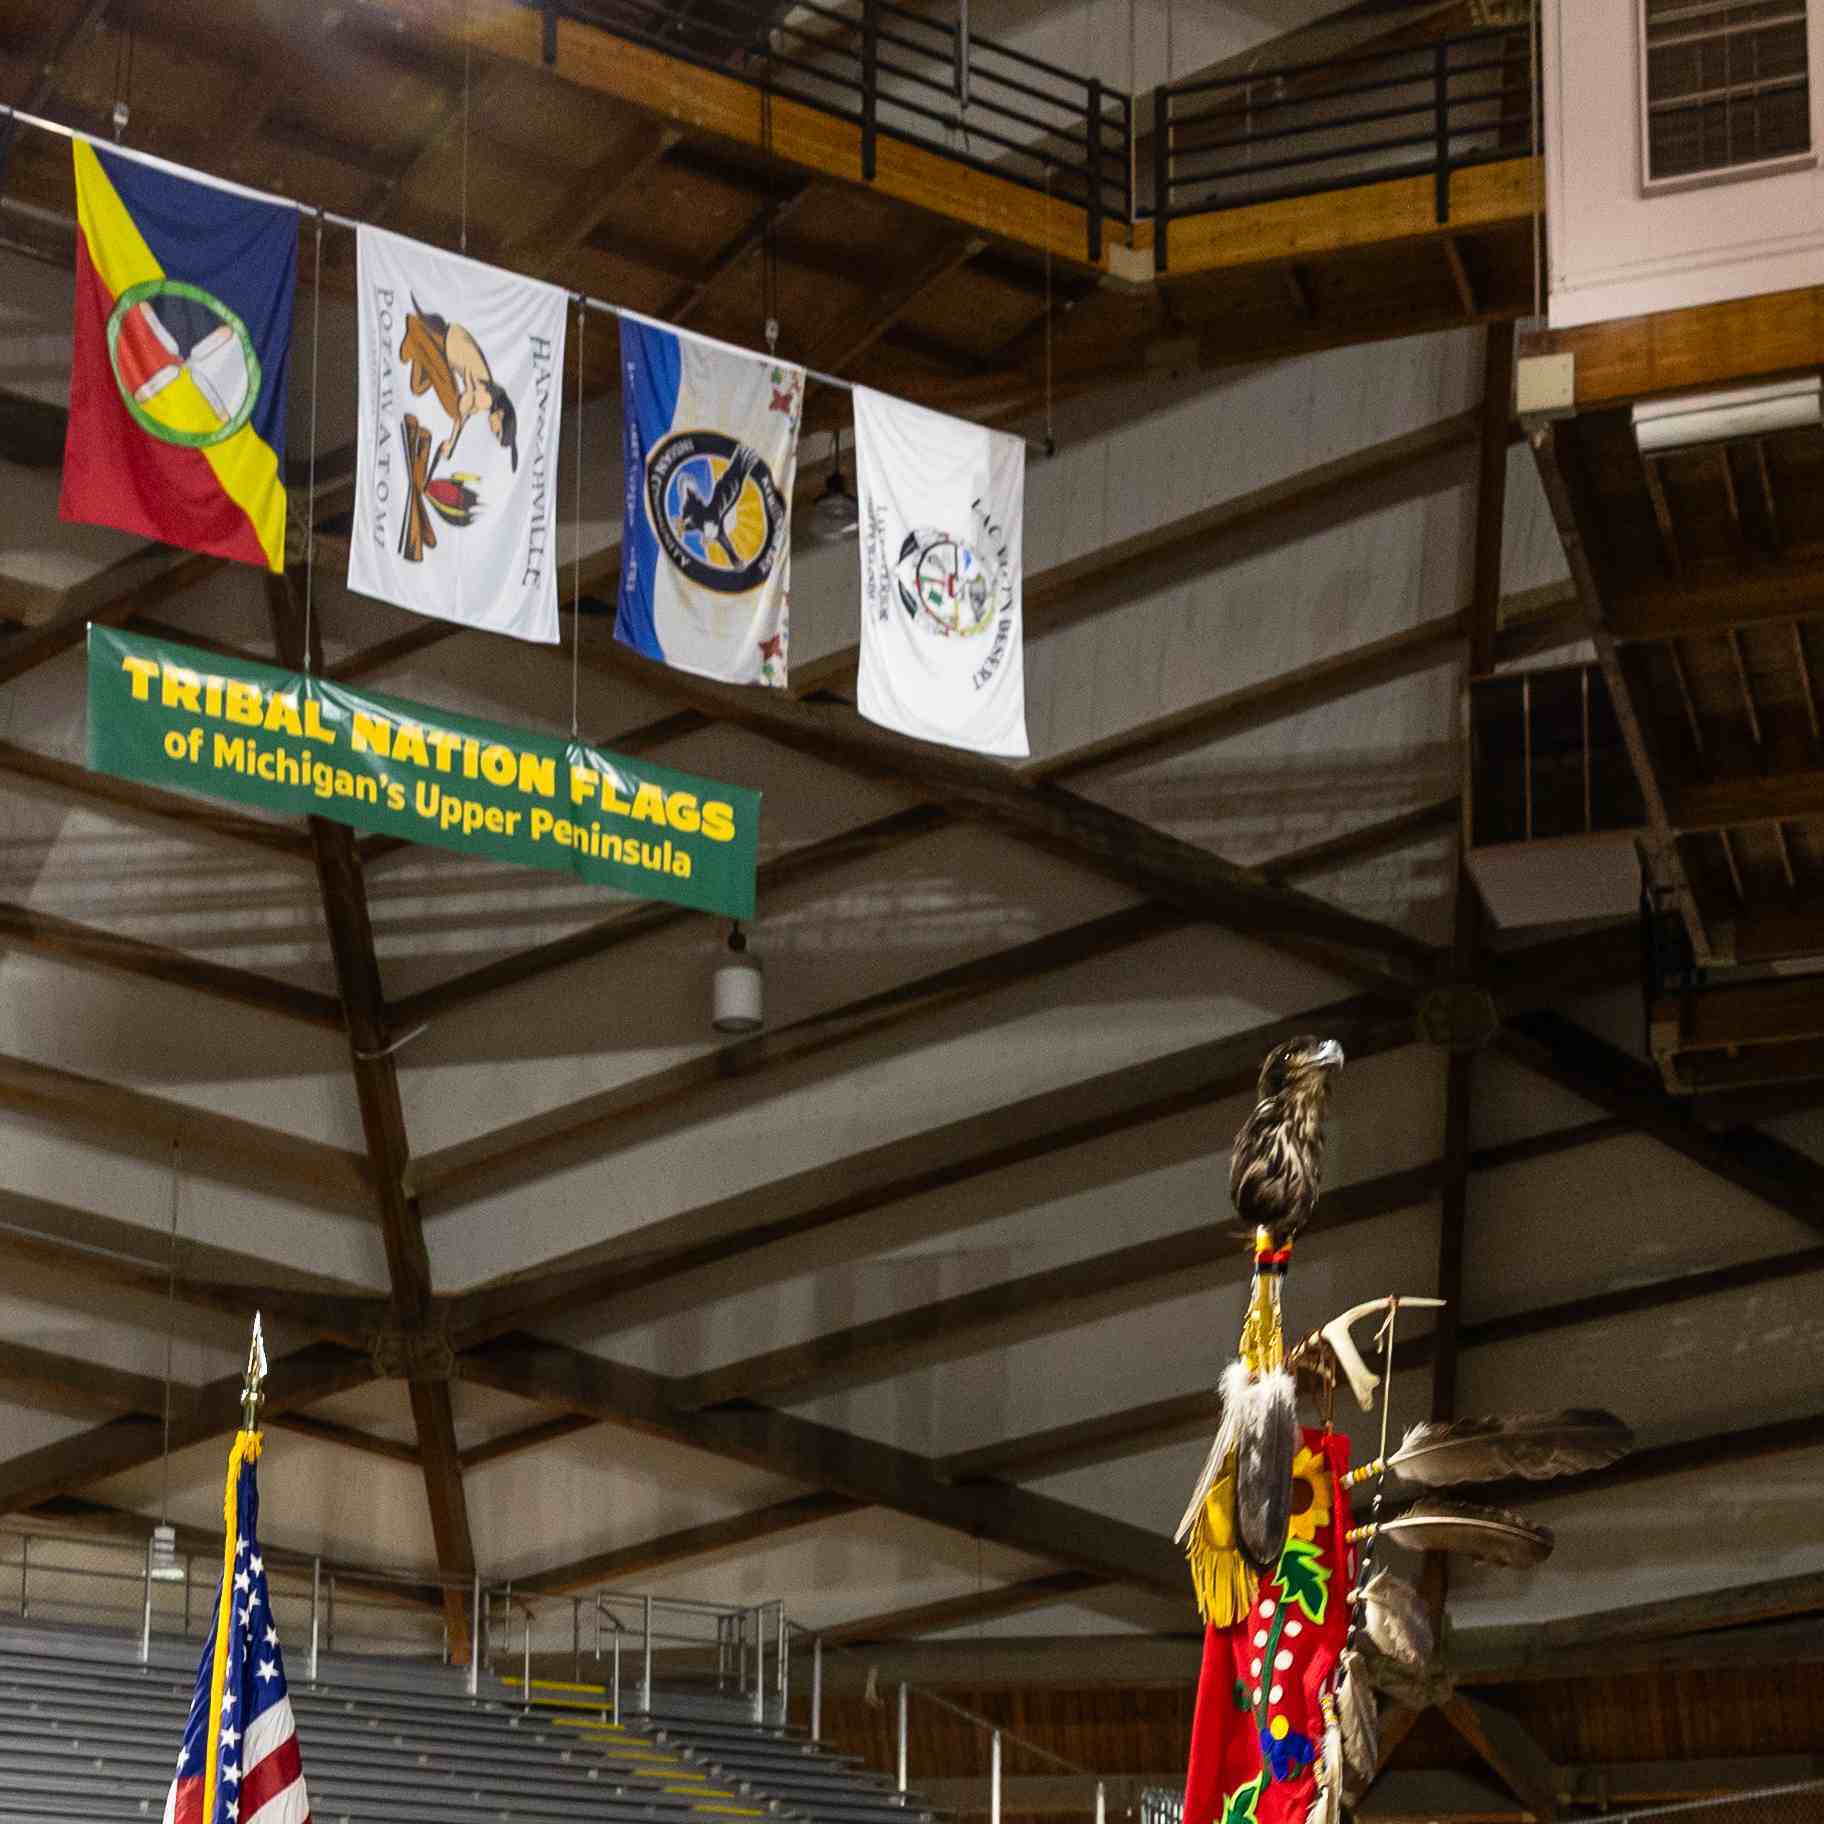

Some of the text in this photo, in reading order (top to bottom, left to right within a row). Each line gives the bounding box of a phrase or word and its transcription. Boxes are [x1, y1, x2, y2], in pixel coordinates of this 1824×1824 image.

[372, 287, 395, 549] POTAWATOMI
[520, 333, 552, 588] HANNAHVILLE
[121, 655, 736, 843] TRIBAL NATION FLAGS
[163, 727, 694, 880] of Michigan's Upper Peninsula
